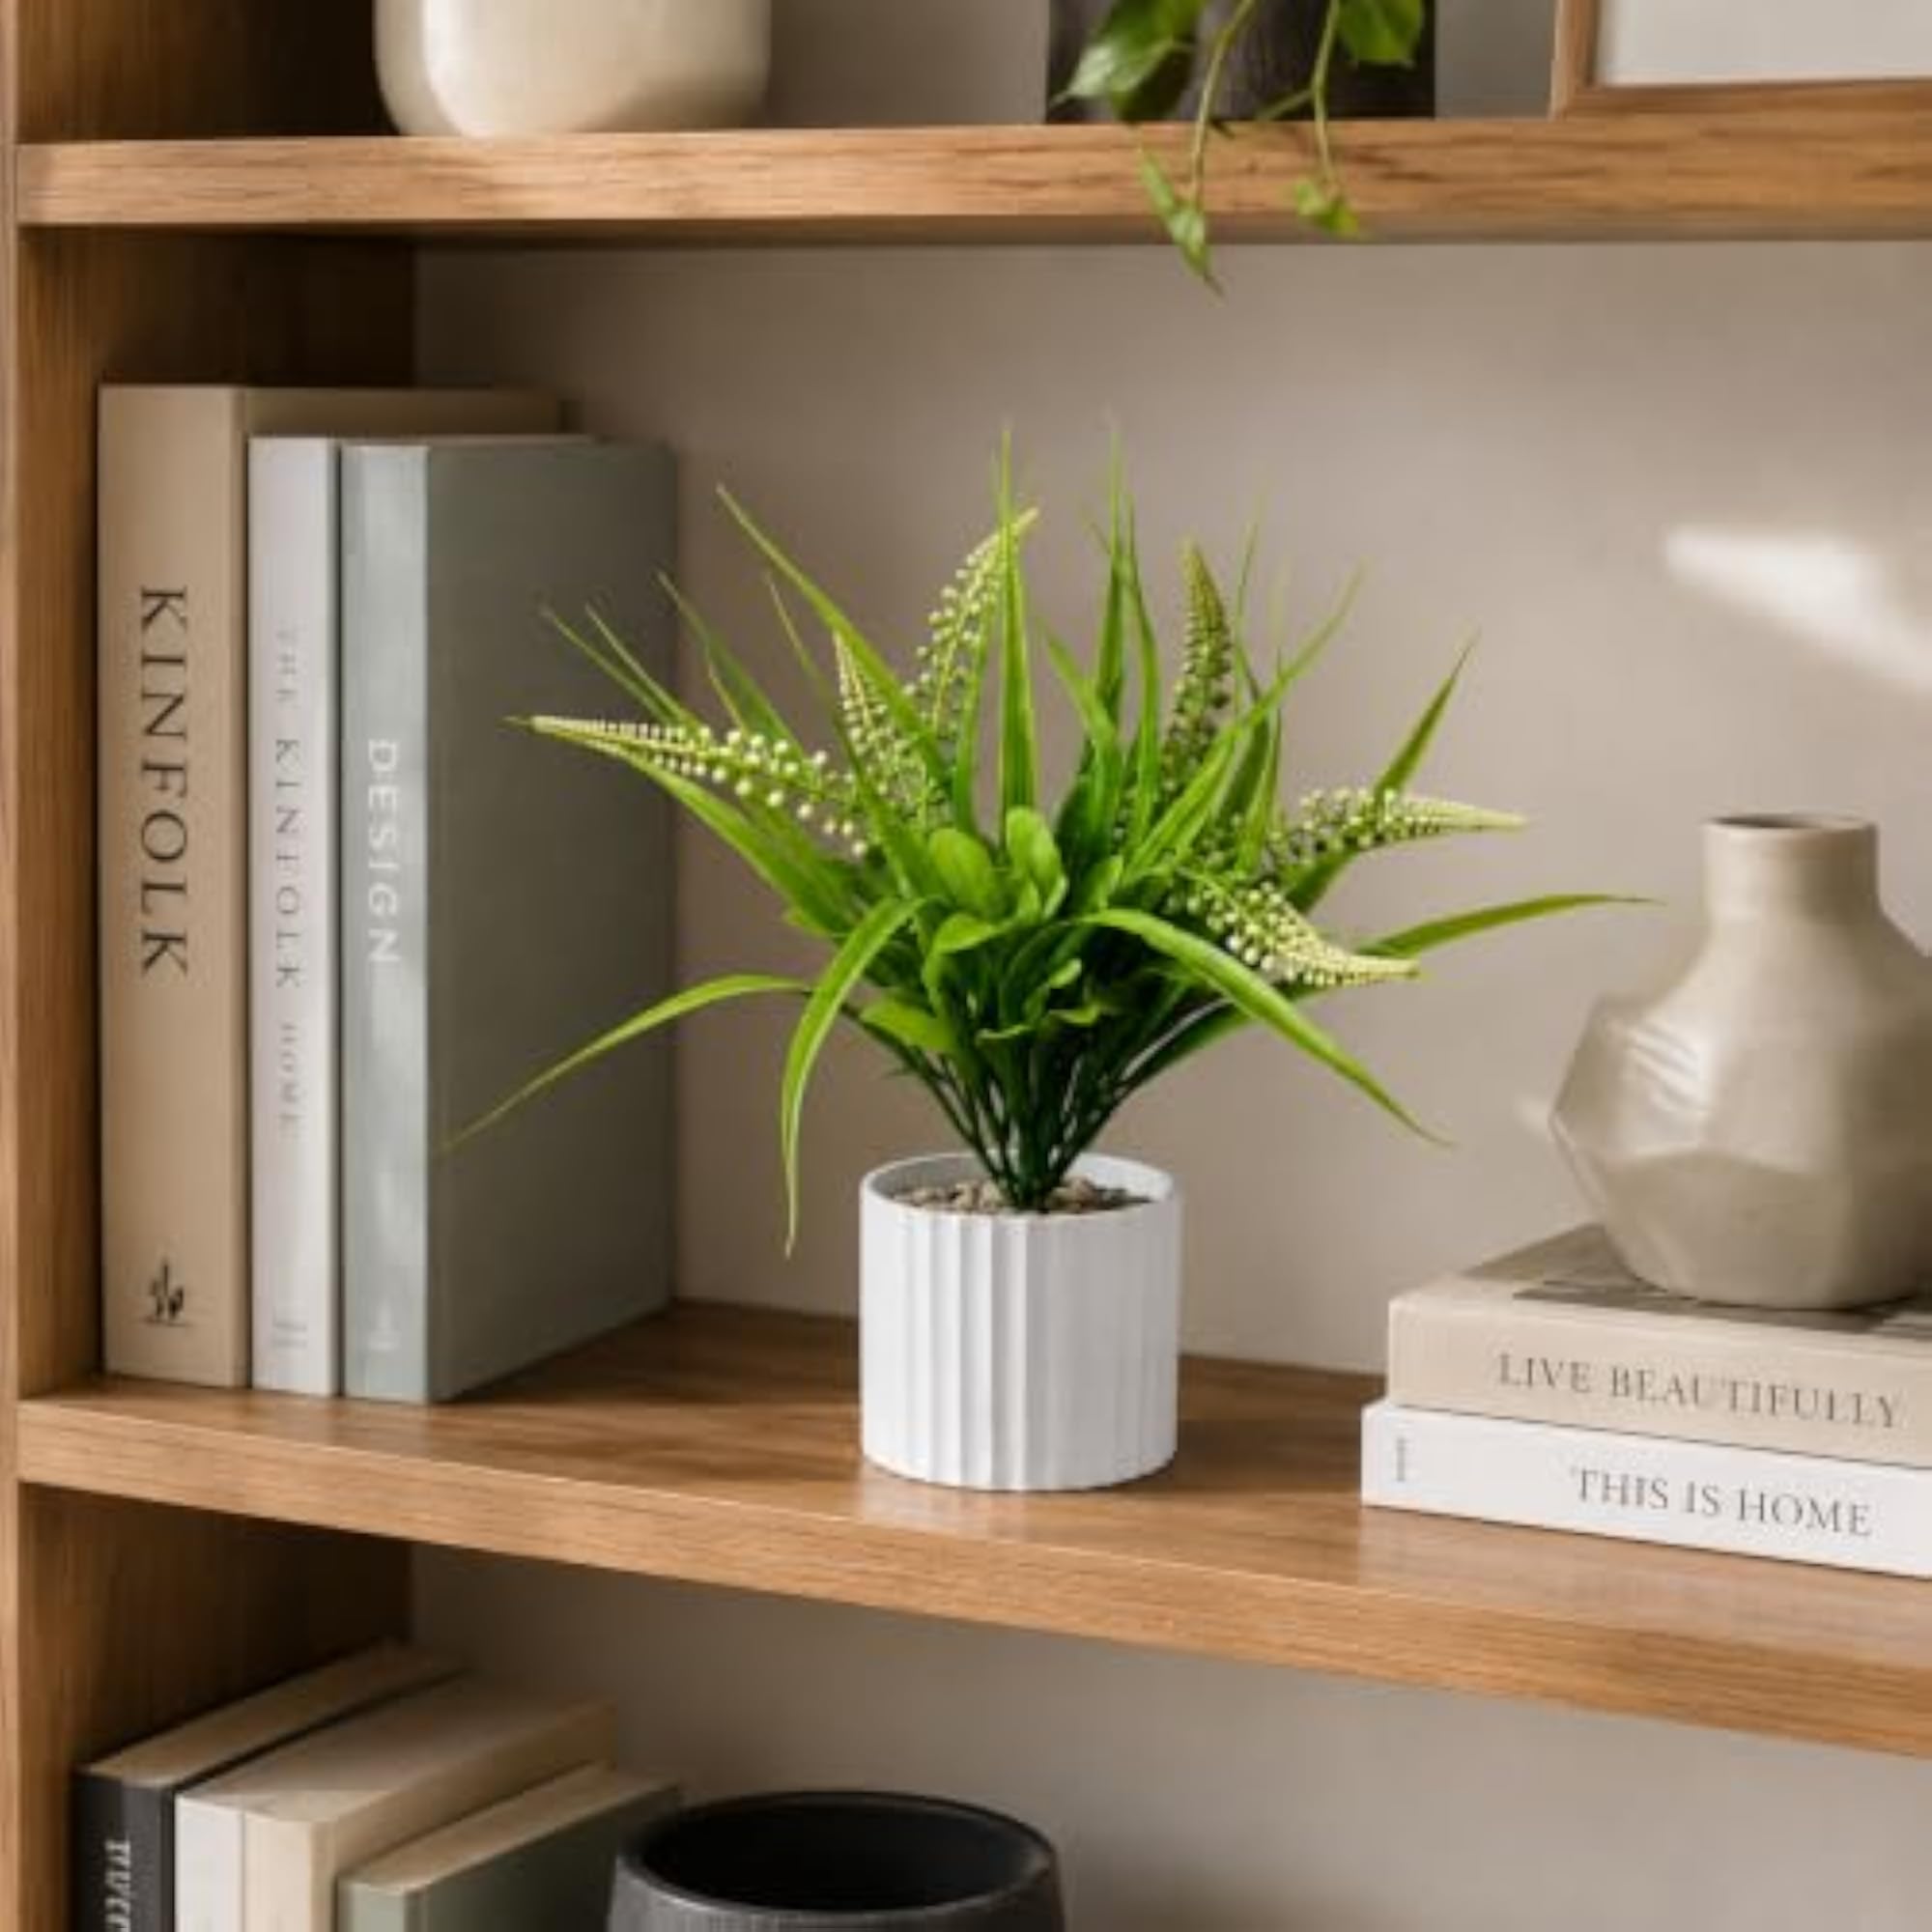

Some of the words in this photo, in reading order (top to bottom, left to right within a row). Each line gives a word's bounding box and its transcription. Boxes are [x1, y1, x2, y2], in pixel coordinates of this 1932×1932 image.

[140, 586, 187, 978] KINFOLK
[276, 738, 301, 989] KINFOLK
[368, 738, 401, 964] DESIGN
[1499, 1353, 1592, 1394] LIVE
[1610, 1365, 1903, 1429] BEAUTIFULLY
[1571, 1465, 1669, 1509] THIS
[1683, 1480, 1721, 1517] IS
[1737, 1488, 1872, 1537] HOME
